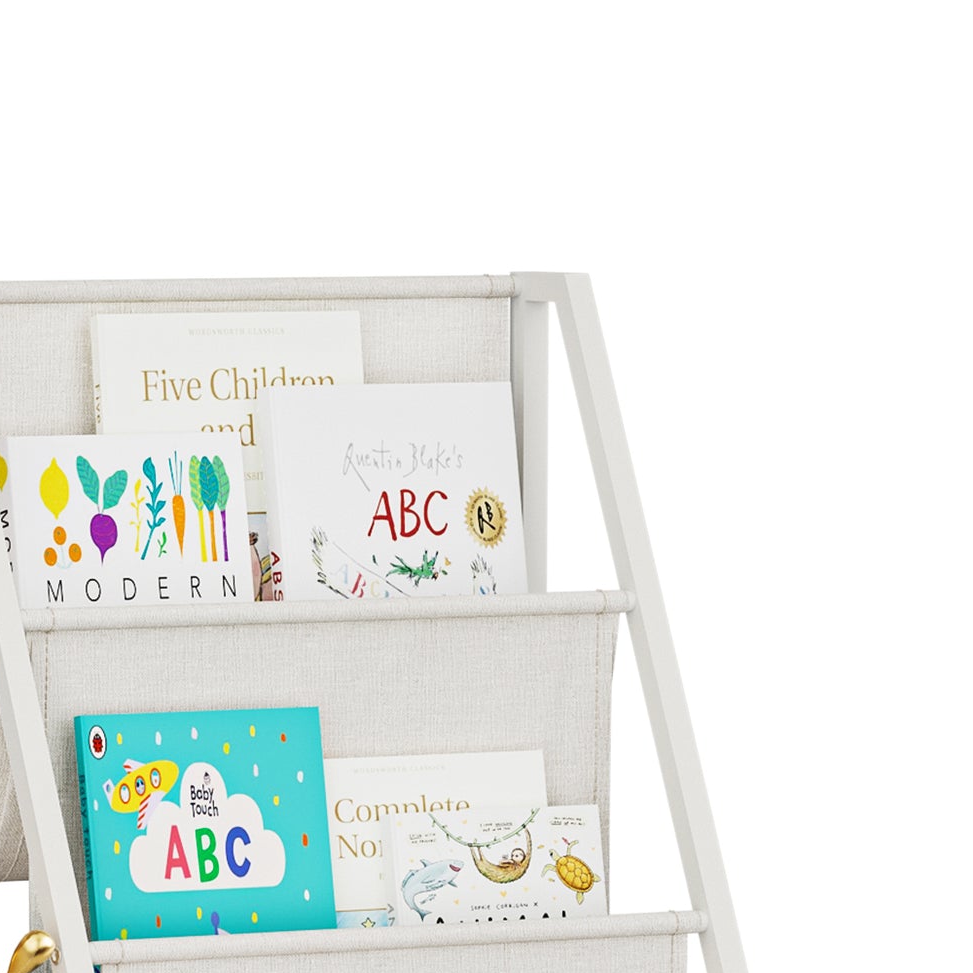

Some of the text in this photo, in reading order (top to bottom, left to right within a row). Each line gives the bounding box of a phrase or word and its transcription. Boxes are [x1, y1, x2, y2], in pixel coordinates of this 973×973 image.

[141, 369, 203, 401] Five
[403, 441, 463, 478] Blake's
[367, 488, 448, 542] ABC
[46, 574, 237, 603] MODERN
[190, 784, 215, 804] Baby
[190, 800, 219, 818] Touch
[164, 824, 252, 883] ABC
